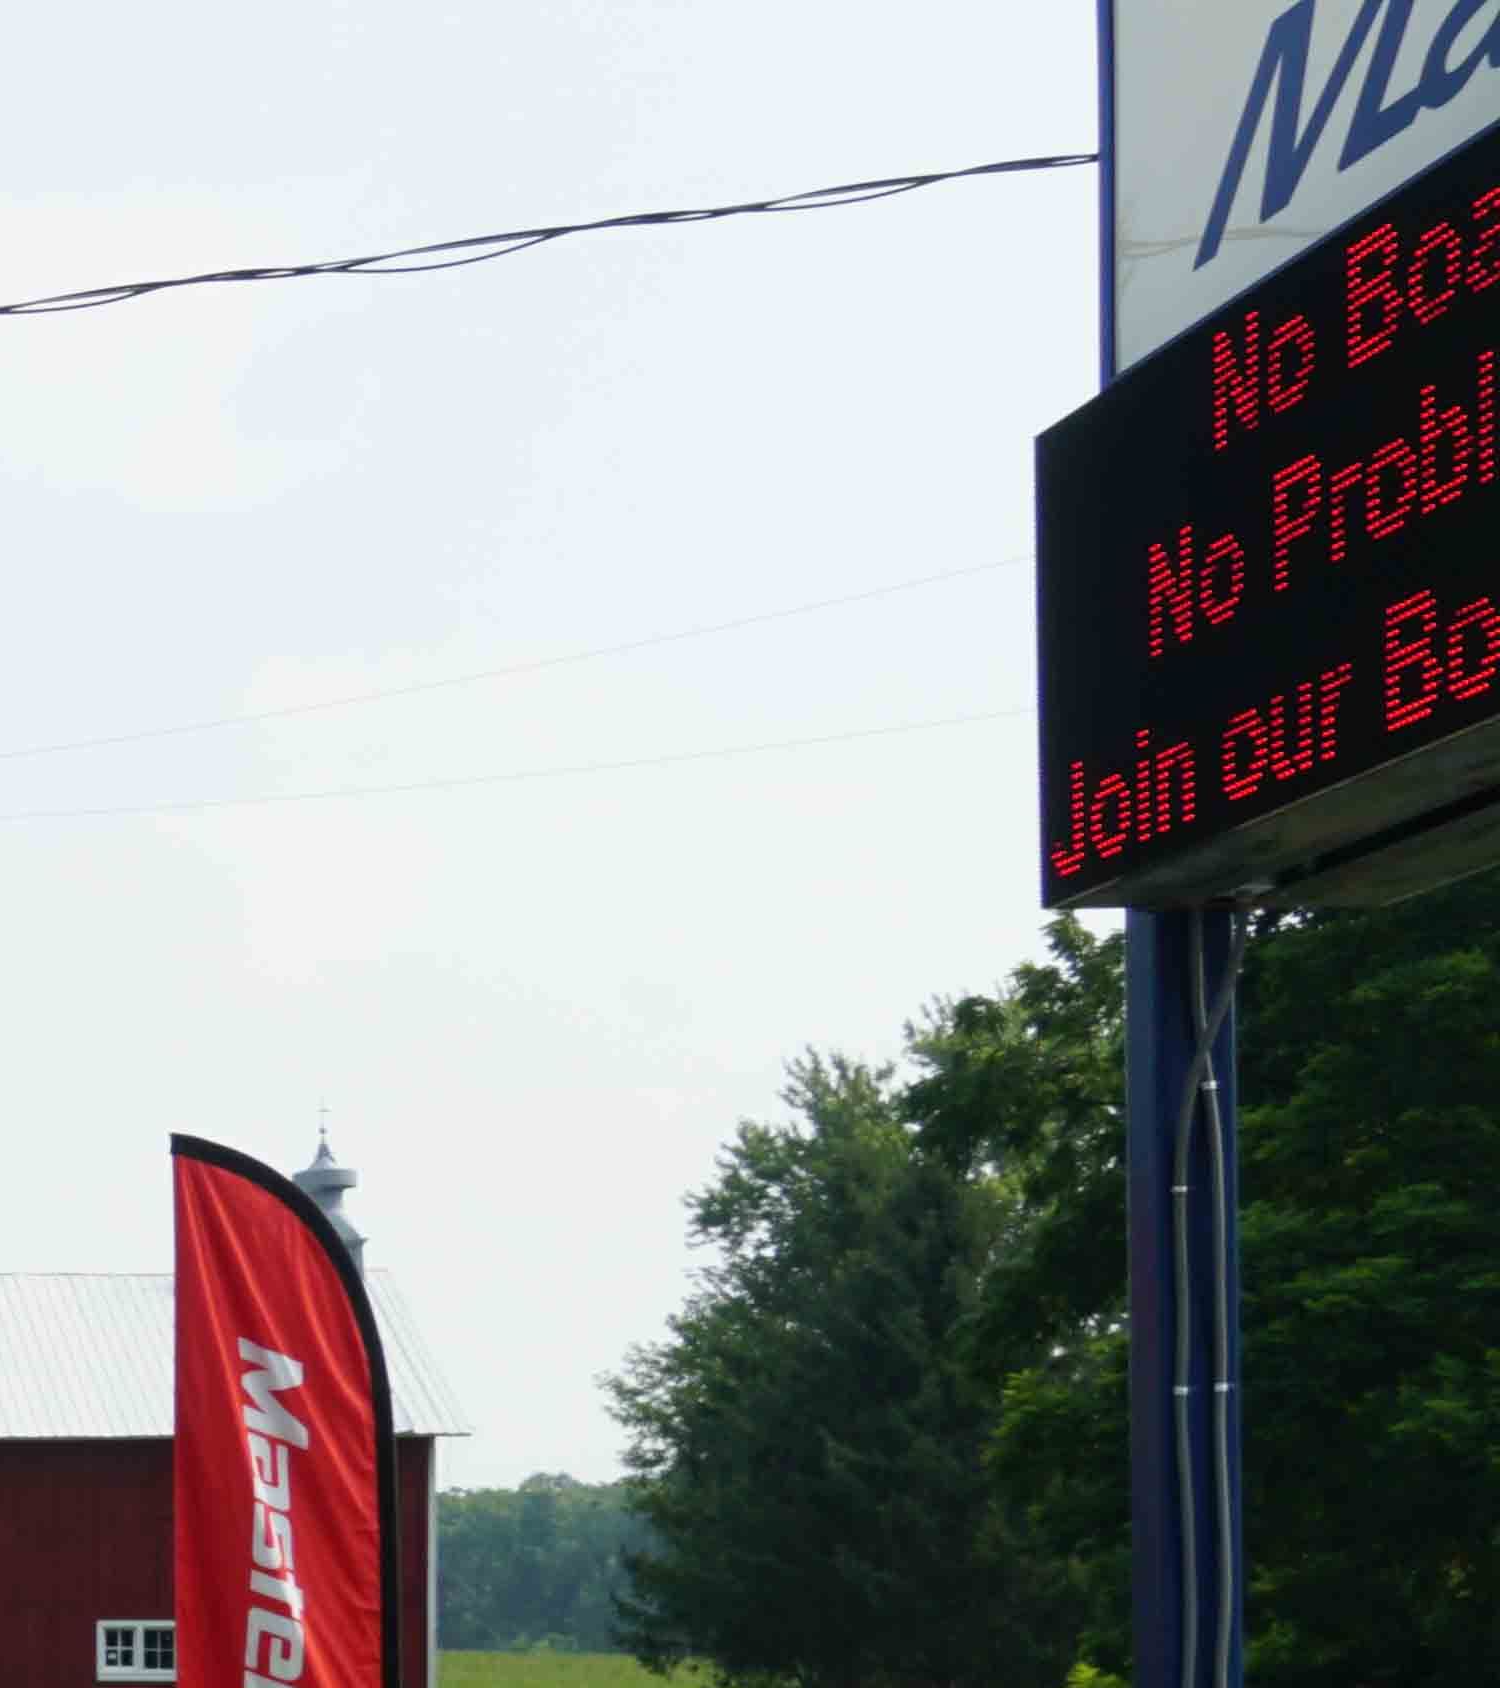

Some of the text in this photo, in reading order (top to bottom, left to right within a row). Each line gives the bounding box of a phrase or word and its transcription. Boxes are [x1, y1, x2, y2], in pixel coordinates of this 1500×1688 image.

[1212, 187, 1500, 449] No Boa
[1148, 351, 1496, 657] No Probl
[1050, 589, 1500, 877] Join our Bo
